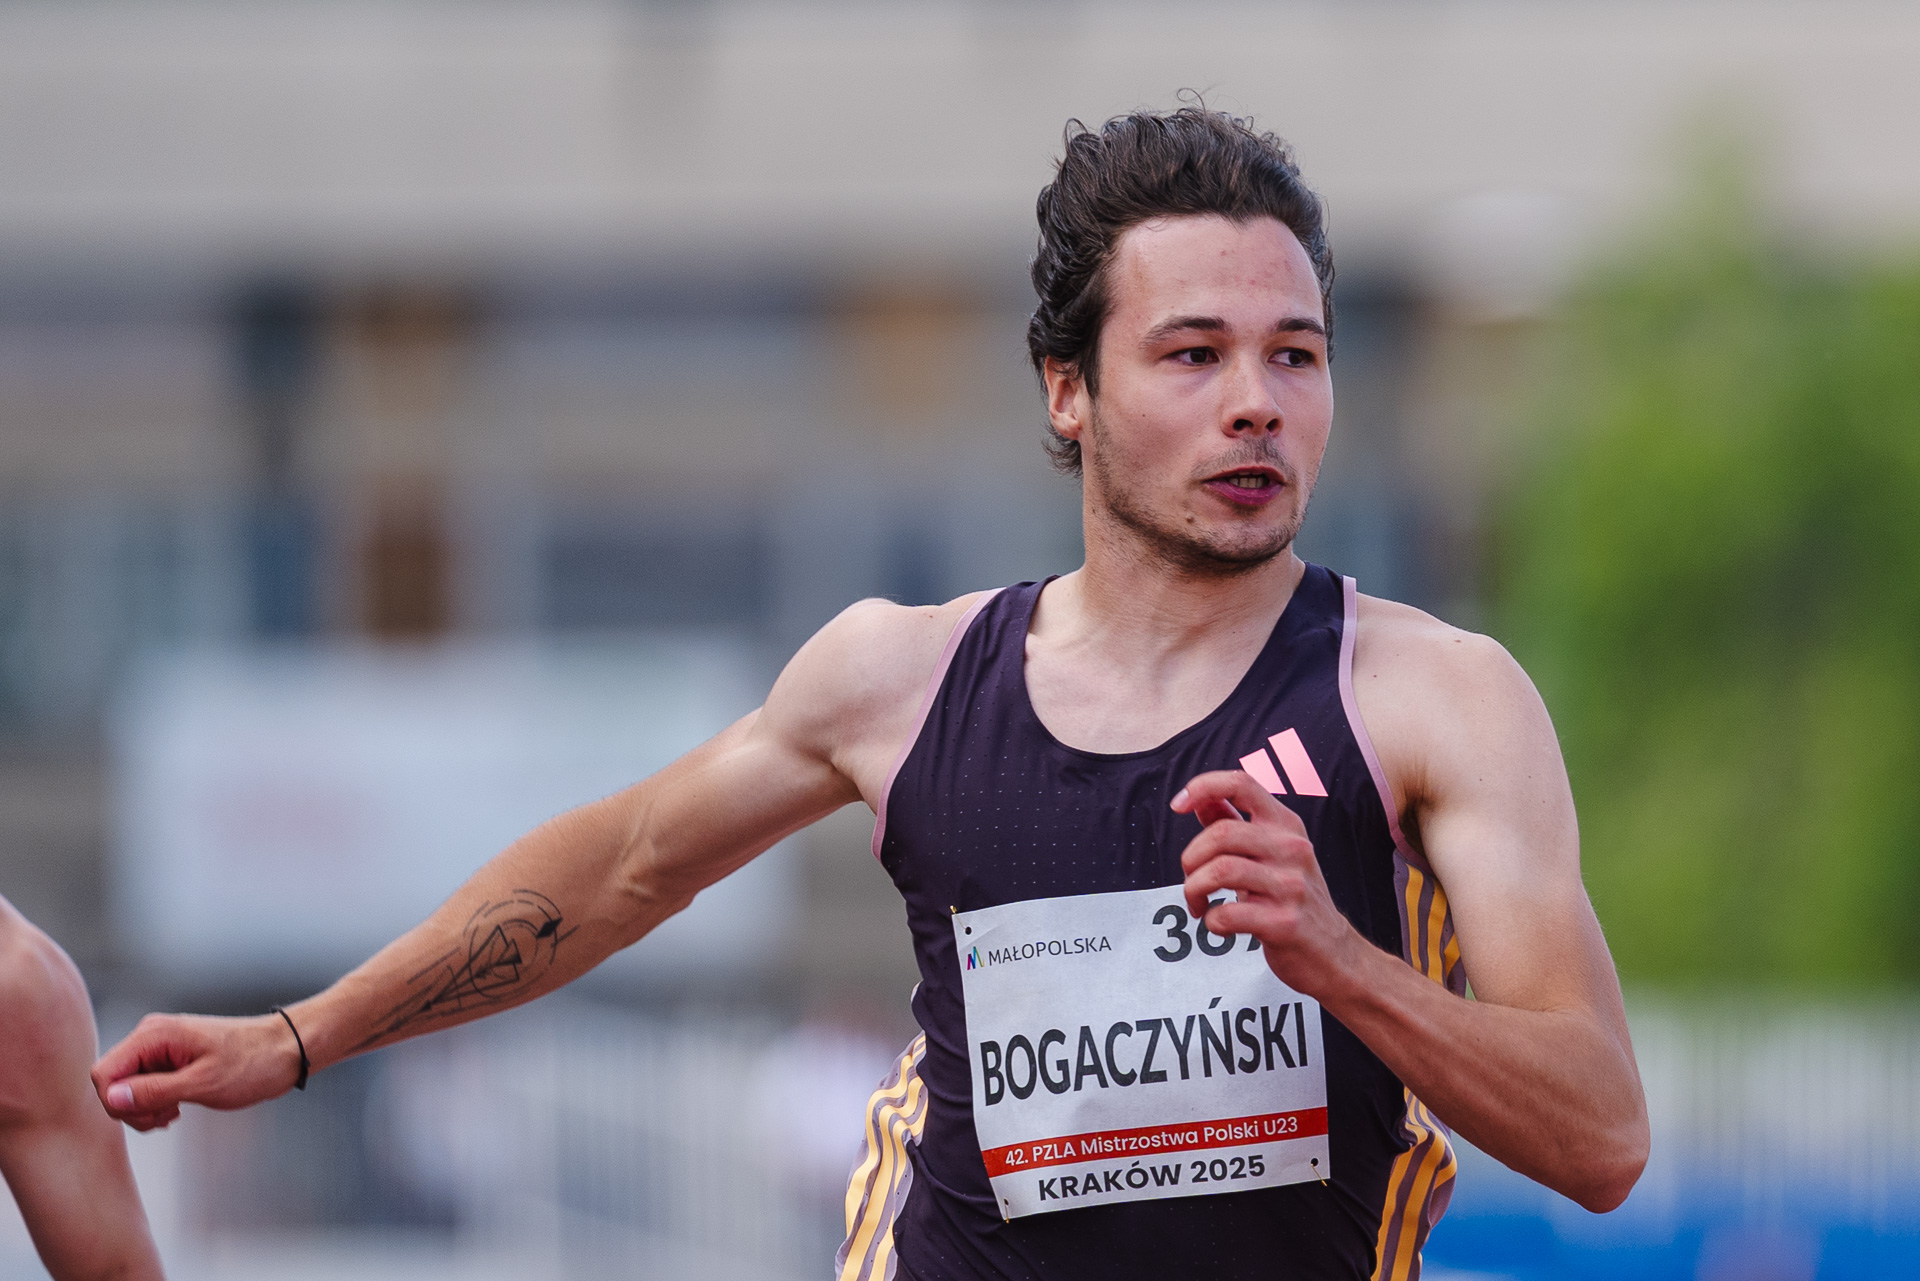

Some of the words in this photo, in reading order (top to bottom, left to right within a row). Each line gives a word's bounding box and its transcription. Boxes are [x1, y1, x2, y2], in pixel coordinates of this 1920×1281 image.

[988, 936, 1112, 966] MAŁOPOLSKA
[1152, 897, 1262, 963] 36
[979, 996, 1309, 1107] BOGACZYŃSKI
[1005, 1148, 1029, 1166] 42.
[1033, 1144, 1076, 1162] PZLA
[1081, 1130, 1199, 1156] Mistrzostwa
[1203, 1120, 1259, 1143] Polski
[1263, 1116, 1298, 1137] U23
[1038, 1160, 1182, 1201] KRAKÓW
[1191, 1154, 1266, 1184] 2025
